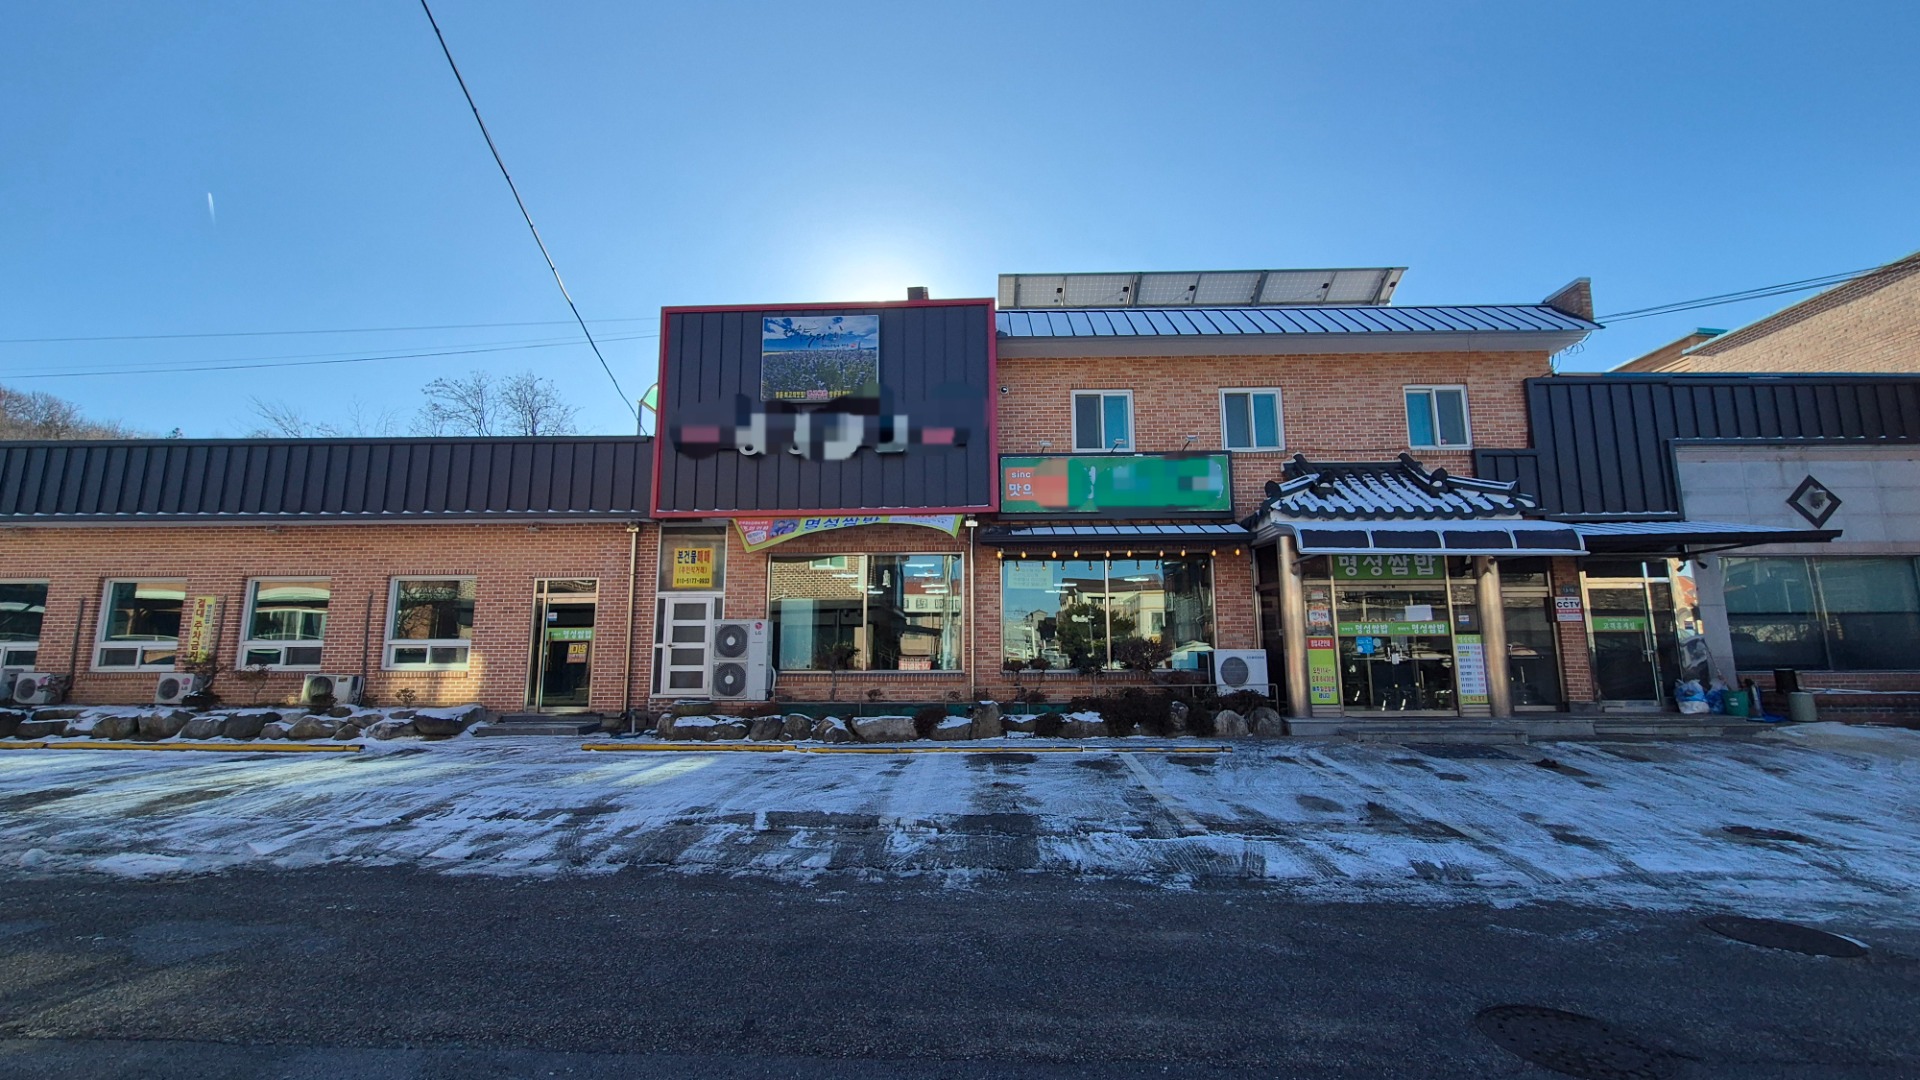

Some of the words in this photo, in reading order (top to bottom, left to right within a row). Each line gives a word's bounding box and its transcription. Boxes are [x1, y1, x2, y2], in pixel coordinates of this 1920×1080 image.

[1011, 470, 1034, 479] sinc
[1338, 554, 1436, 577] 명성쌈밥
[563, 629, 592, 640] 명성쌈밥
[1355, 624, 1389, 635] 명성쌈밥
[1411, 624, 1446, 635] 명성쌈밥
